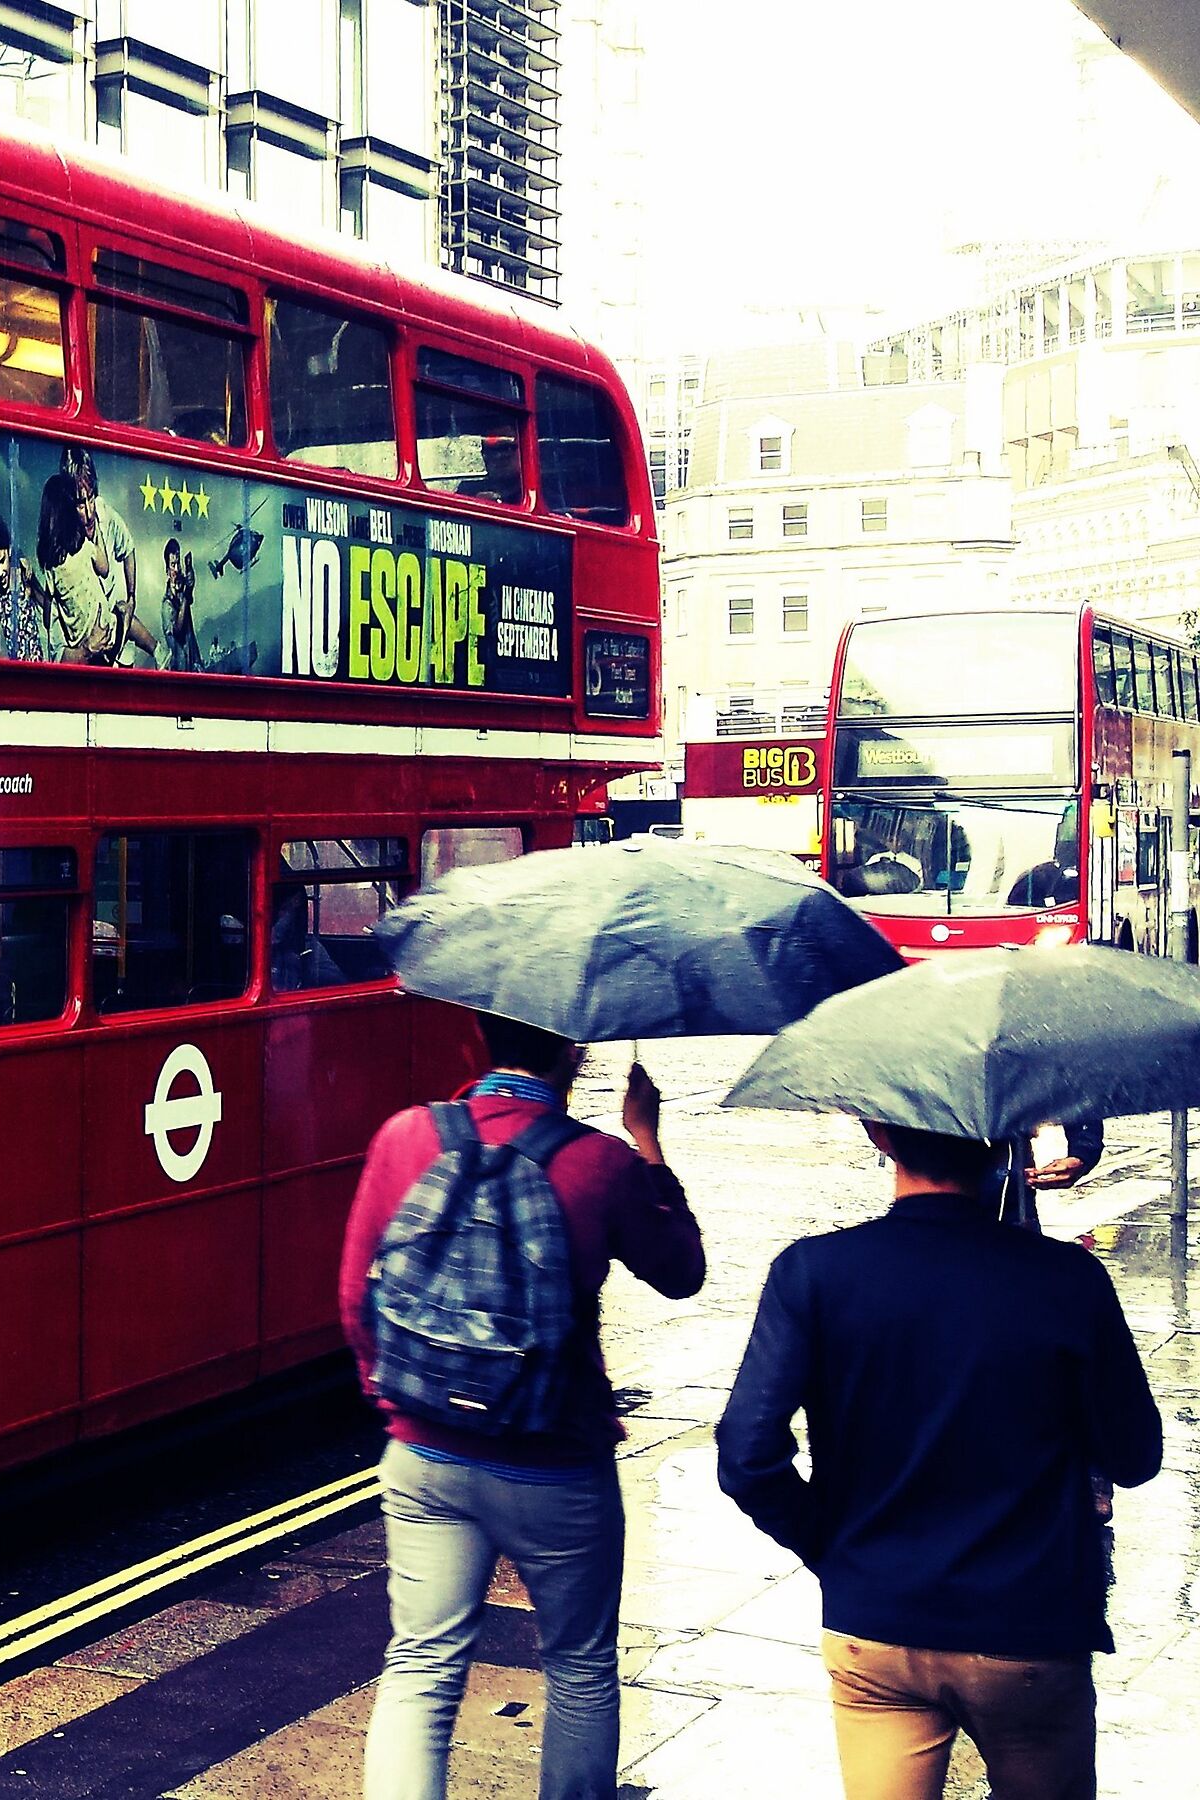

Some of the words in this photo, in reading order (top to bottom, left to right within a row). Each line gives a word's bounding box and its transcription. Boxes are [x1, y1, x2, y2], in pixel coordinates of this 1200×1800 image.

[306, 497, 348, 538] WILSON
[369, 508, 394, 545] BELL
[281, 535, 341, 678] NO
[349, 545, 486, 686] ESCAPE
[502, 585, 513, 620] IN
[513, 586, 555, 625] CINEMAS
[497, 621, 551, 661] SEPTEMBER
[551, 627, 559, 662] 4
[743, 747, 784, 769] BIG
[743, 768, 784, 788] BUS
